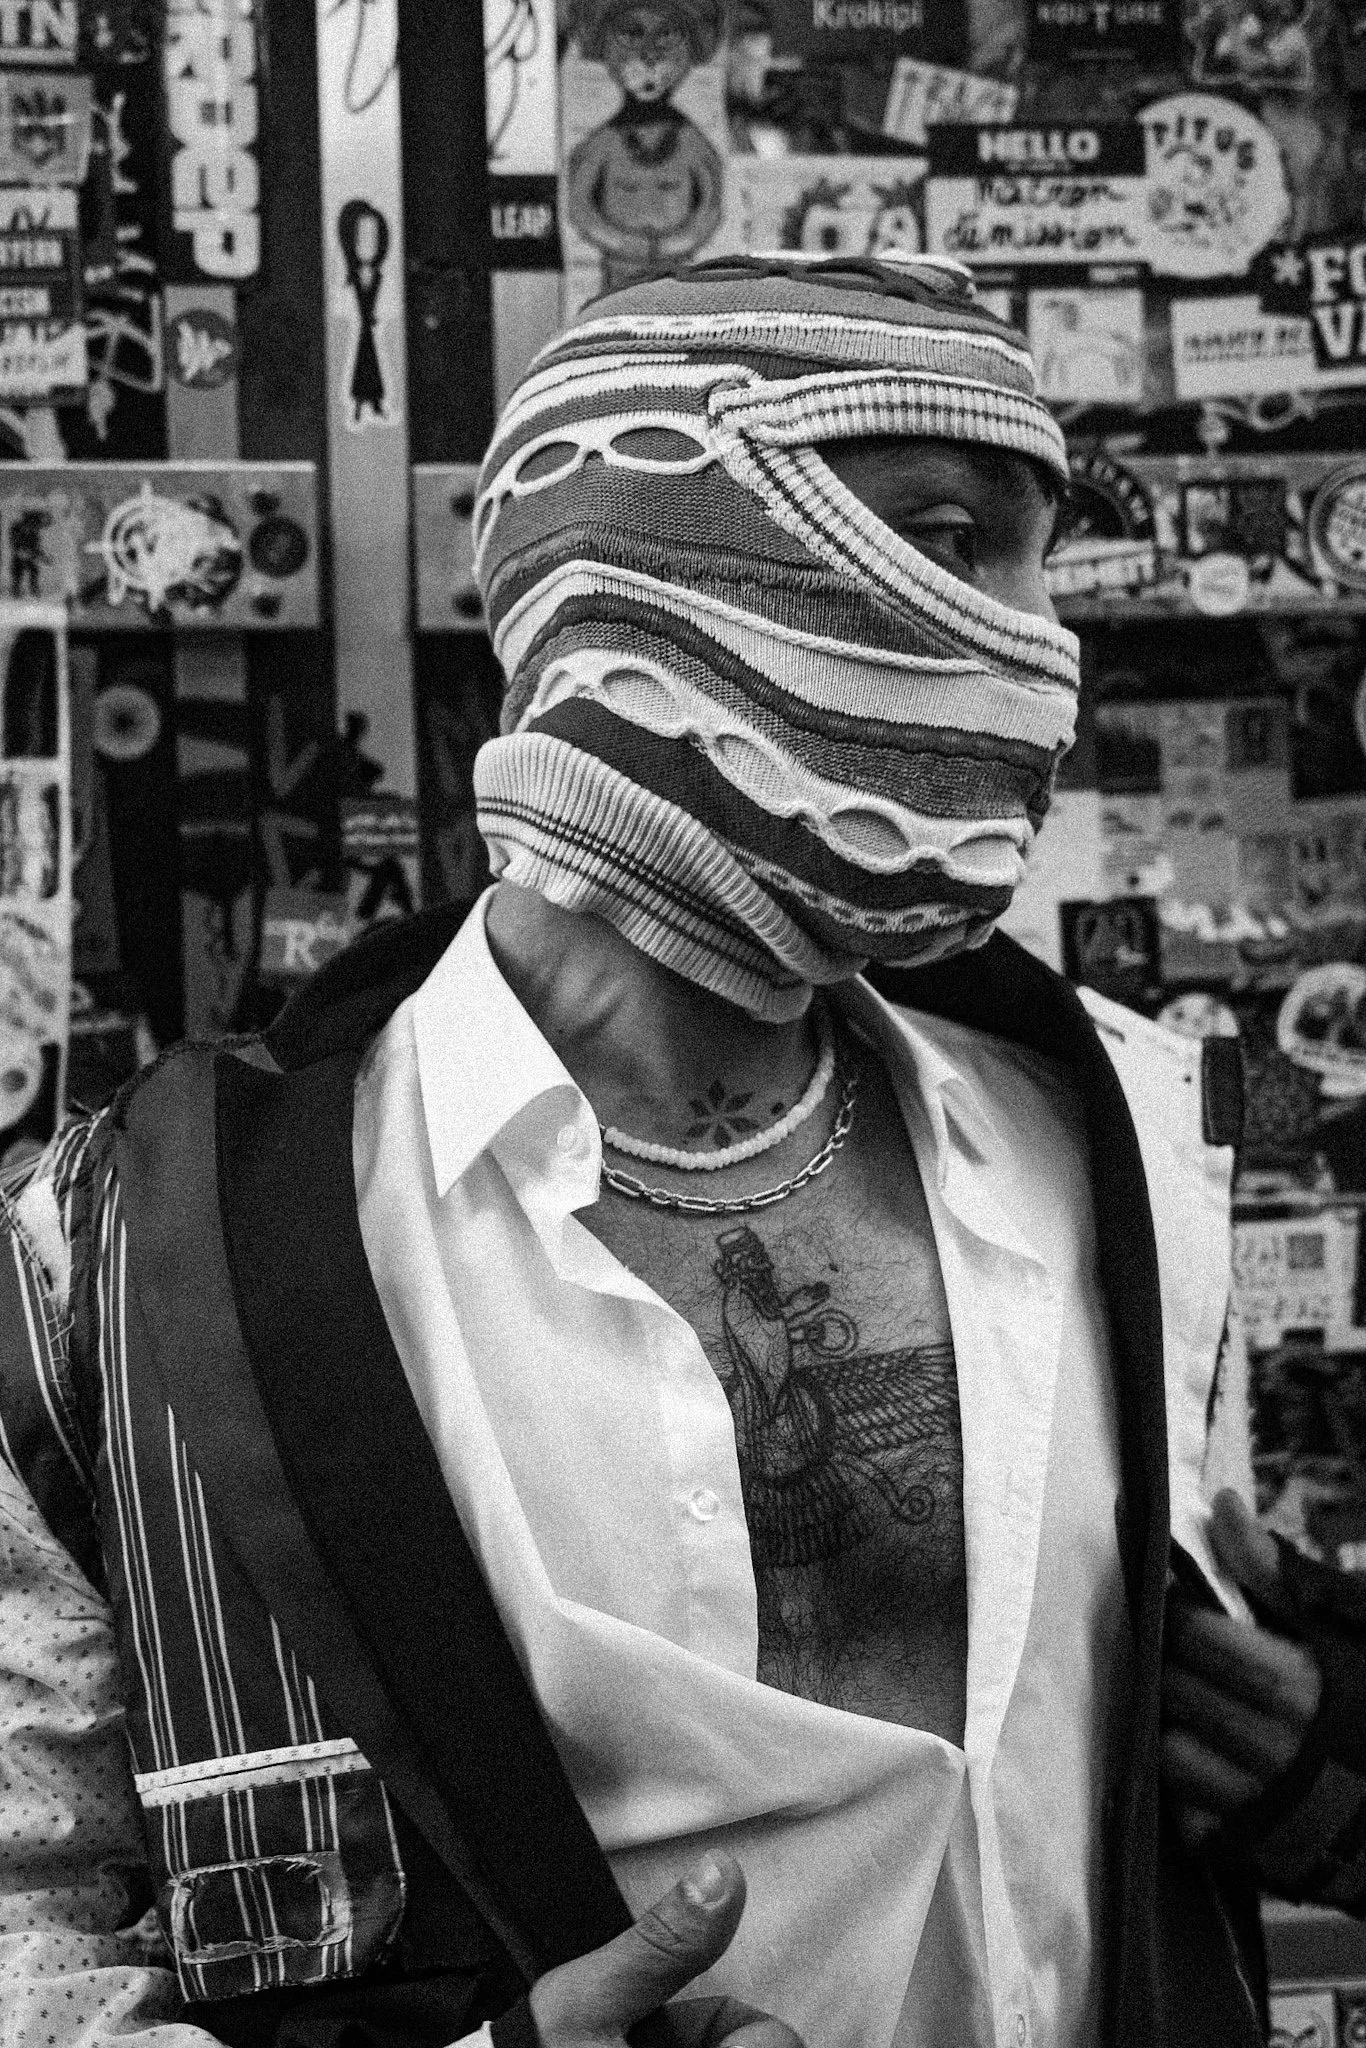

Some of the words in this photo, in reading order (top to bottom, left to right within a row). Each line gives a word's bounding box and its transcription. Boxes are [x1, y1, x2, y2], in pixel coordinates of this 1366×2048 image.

[978, 130, 1099, 161] HELLO
[1150, 116, 1256, 171] TITUS
[491, 203, 552, 239] LEAP
